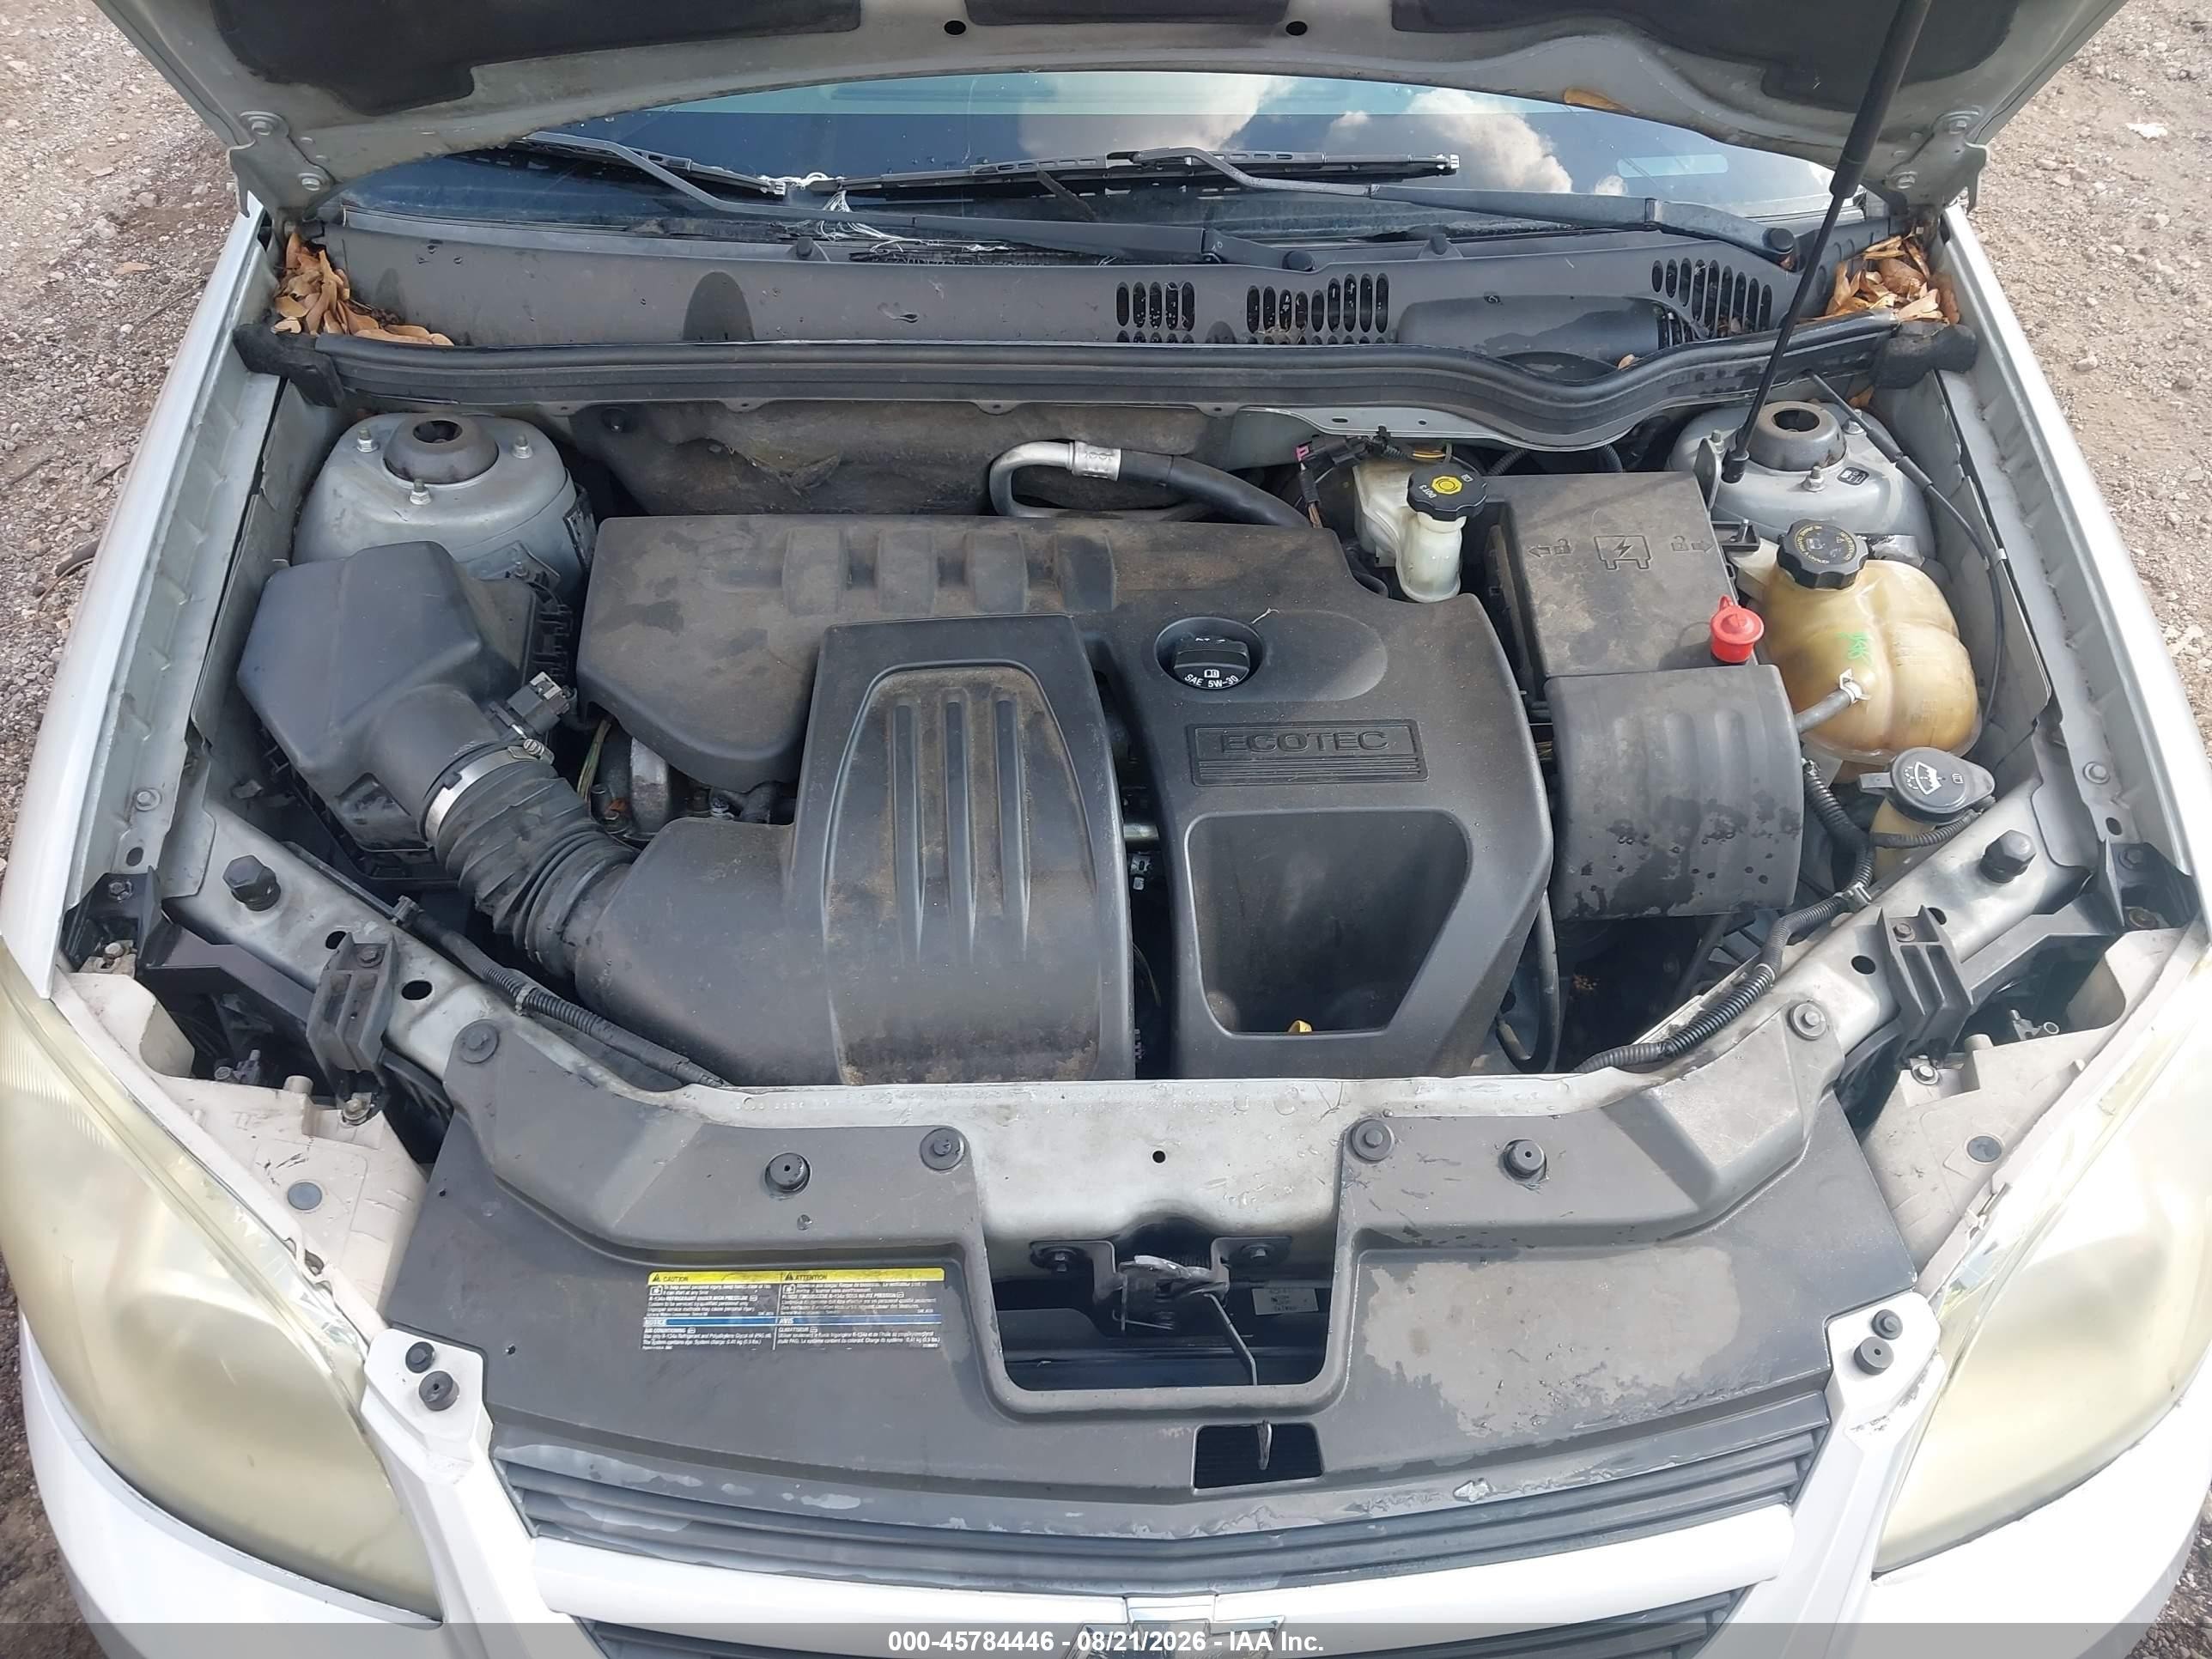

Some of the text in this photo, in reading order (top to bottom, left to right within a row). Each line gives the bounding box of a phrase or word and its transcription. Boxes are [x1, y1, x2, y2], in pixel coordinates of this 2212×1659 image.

[1422, 489, 1437, 498] DOT
[1185, 674, 1238, 687] SAE 5W-30
[1221, 731, 1389, 754] ECOTEC
